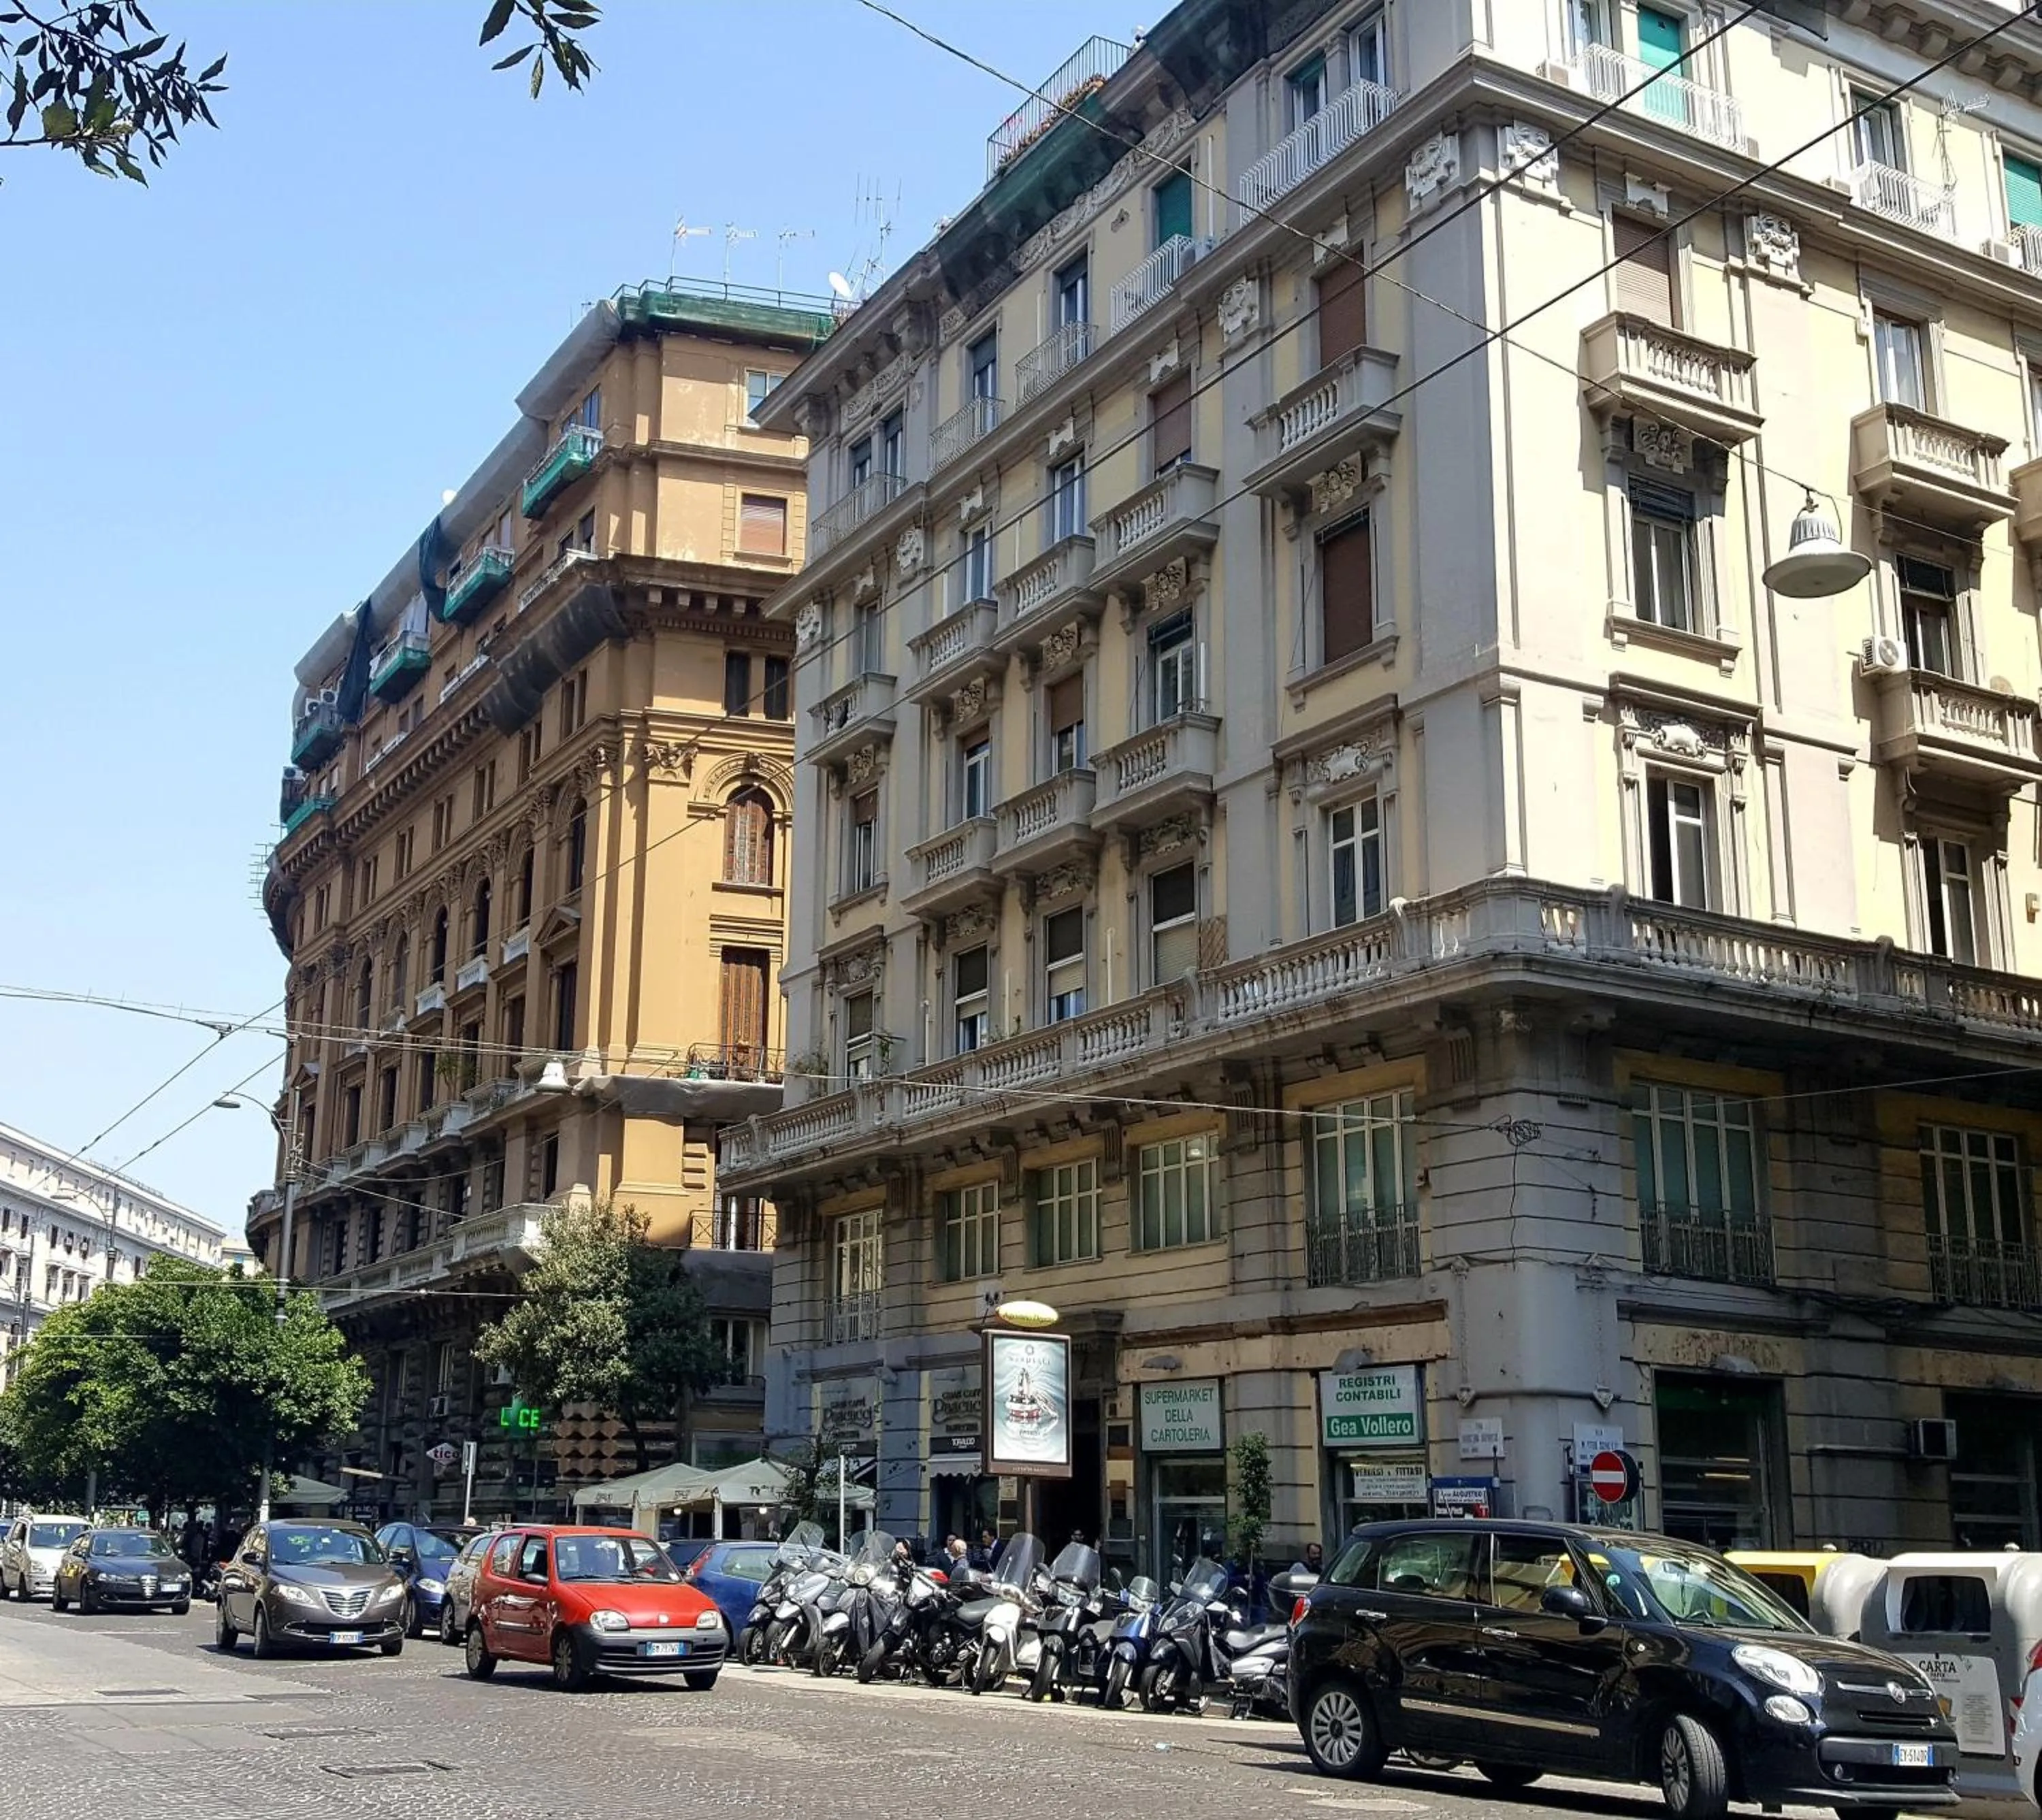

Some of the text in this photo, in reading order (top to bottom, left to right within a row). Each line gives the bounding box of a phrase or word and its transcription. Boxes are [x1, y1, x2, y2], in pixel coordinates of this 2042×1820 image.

[1339, 1375, 1395, 1388] REGISTRI
[1144, 1388, 1214, 1404] SUPERMARKET
[1335, 1388, 1400, 1402] CONTABILI
[1165, 1408, 1193, 1423] DELLA
[1331, 1416, 1411, 1436] Gea Vollero
[1151, 1427, 1210, 1442] CARTOLERIA
[1919, 1660, 1957, 1674] CARTA
